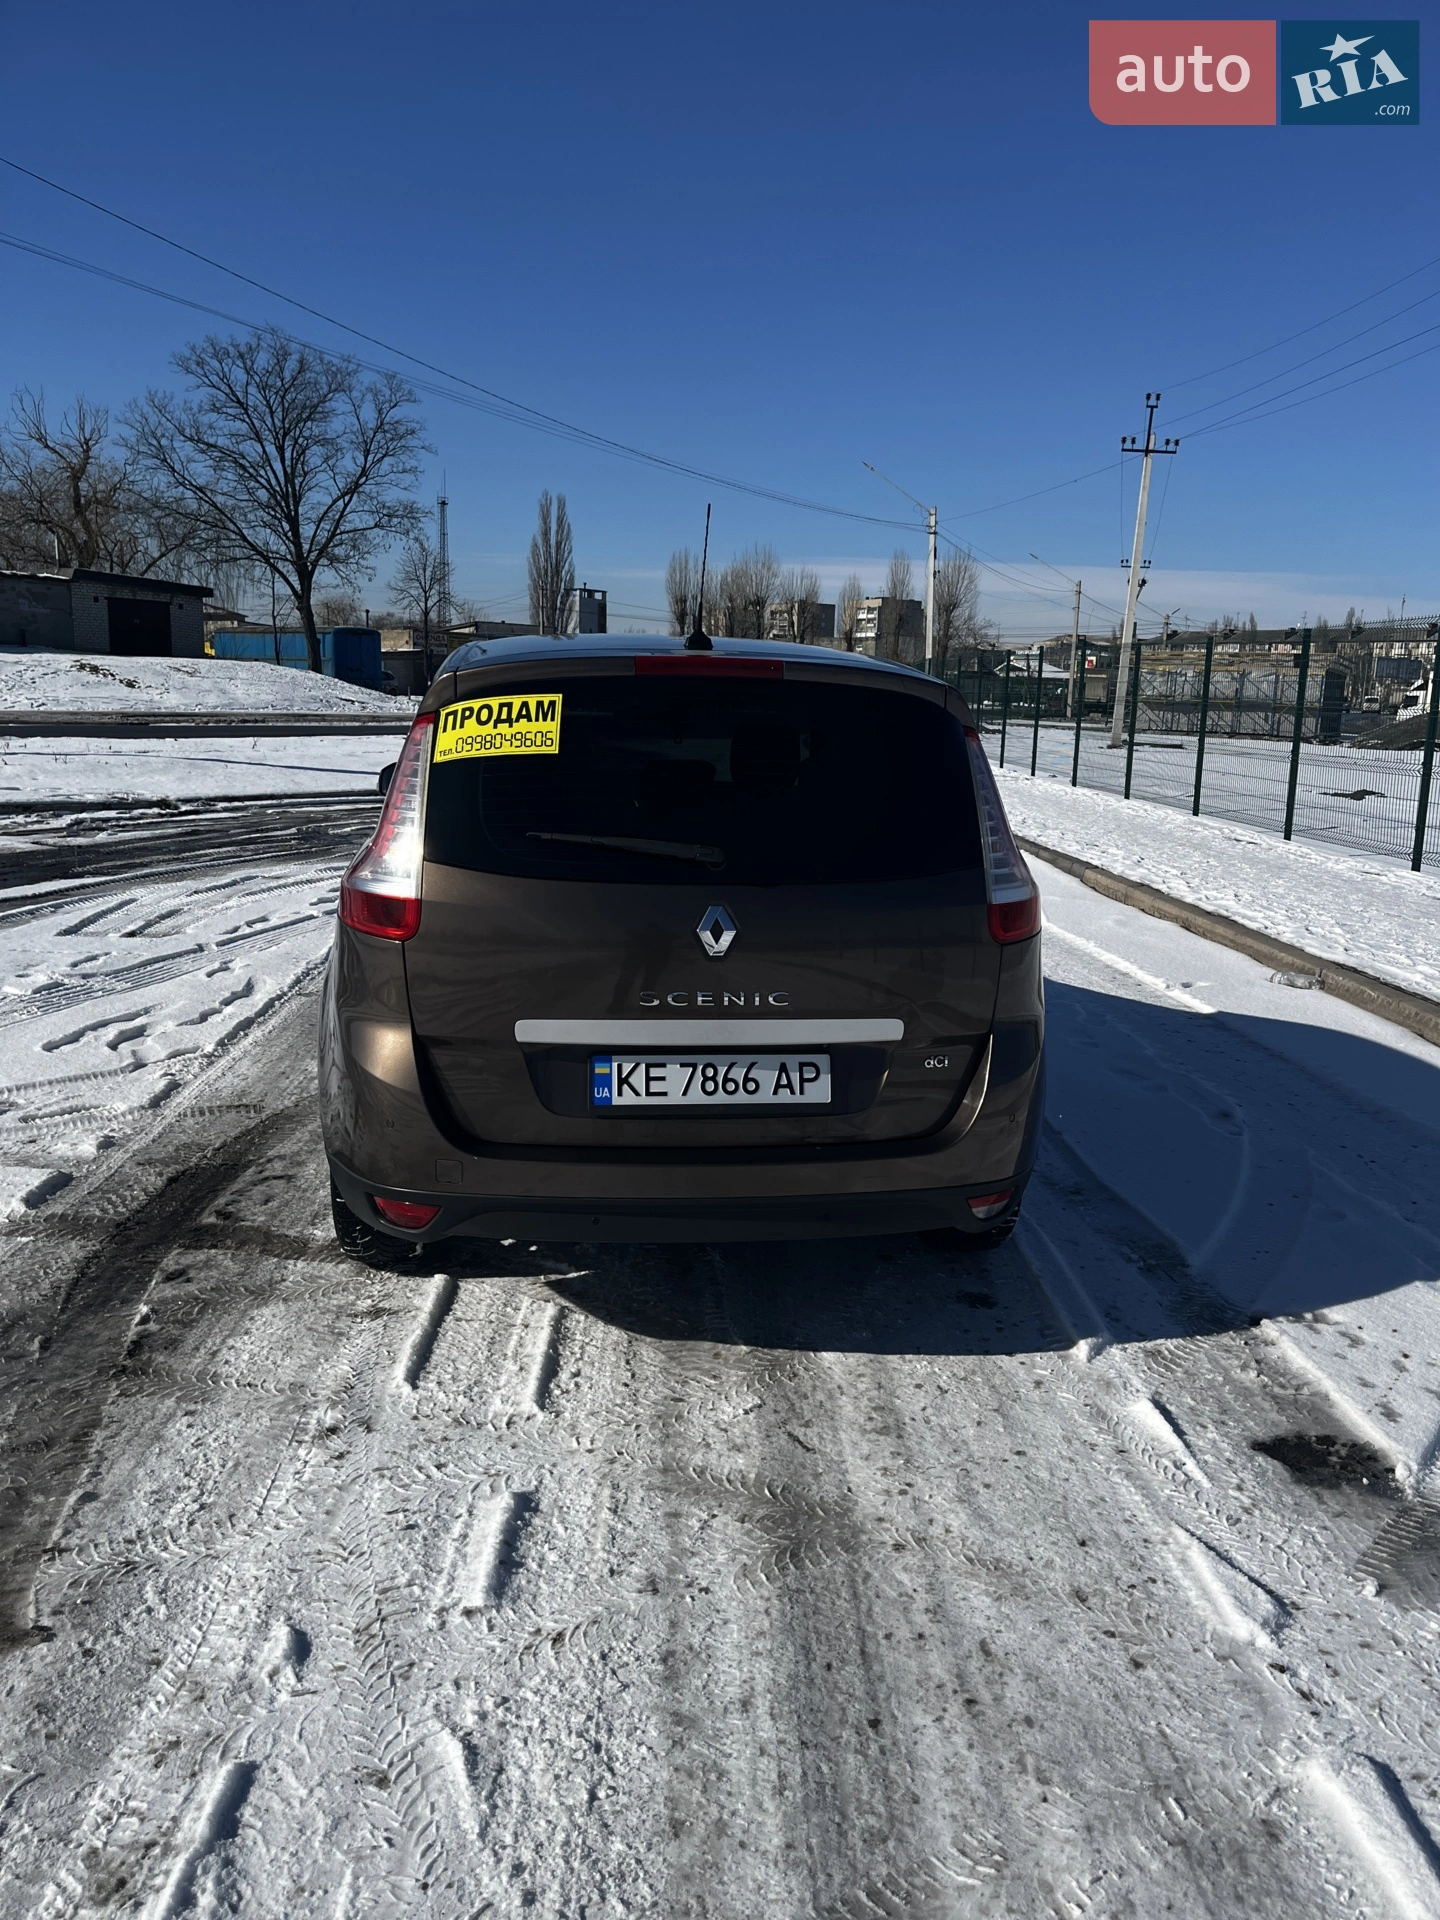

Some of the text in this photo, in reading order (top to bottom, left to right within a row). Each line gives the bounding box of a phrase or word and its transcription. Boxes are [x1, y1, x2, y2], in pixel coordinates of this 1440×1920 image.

[442, 700, 557, 733] ПРОДАМ
[455, 731, 554, 753] 0998049606
[639, 991, 789, 1006] SCENIC
[616, 1061, 820, 1097] KE 7866 AP
[594, 1087, 610, 1097] UA
